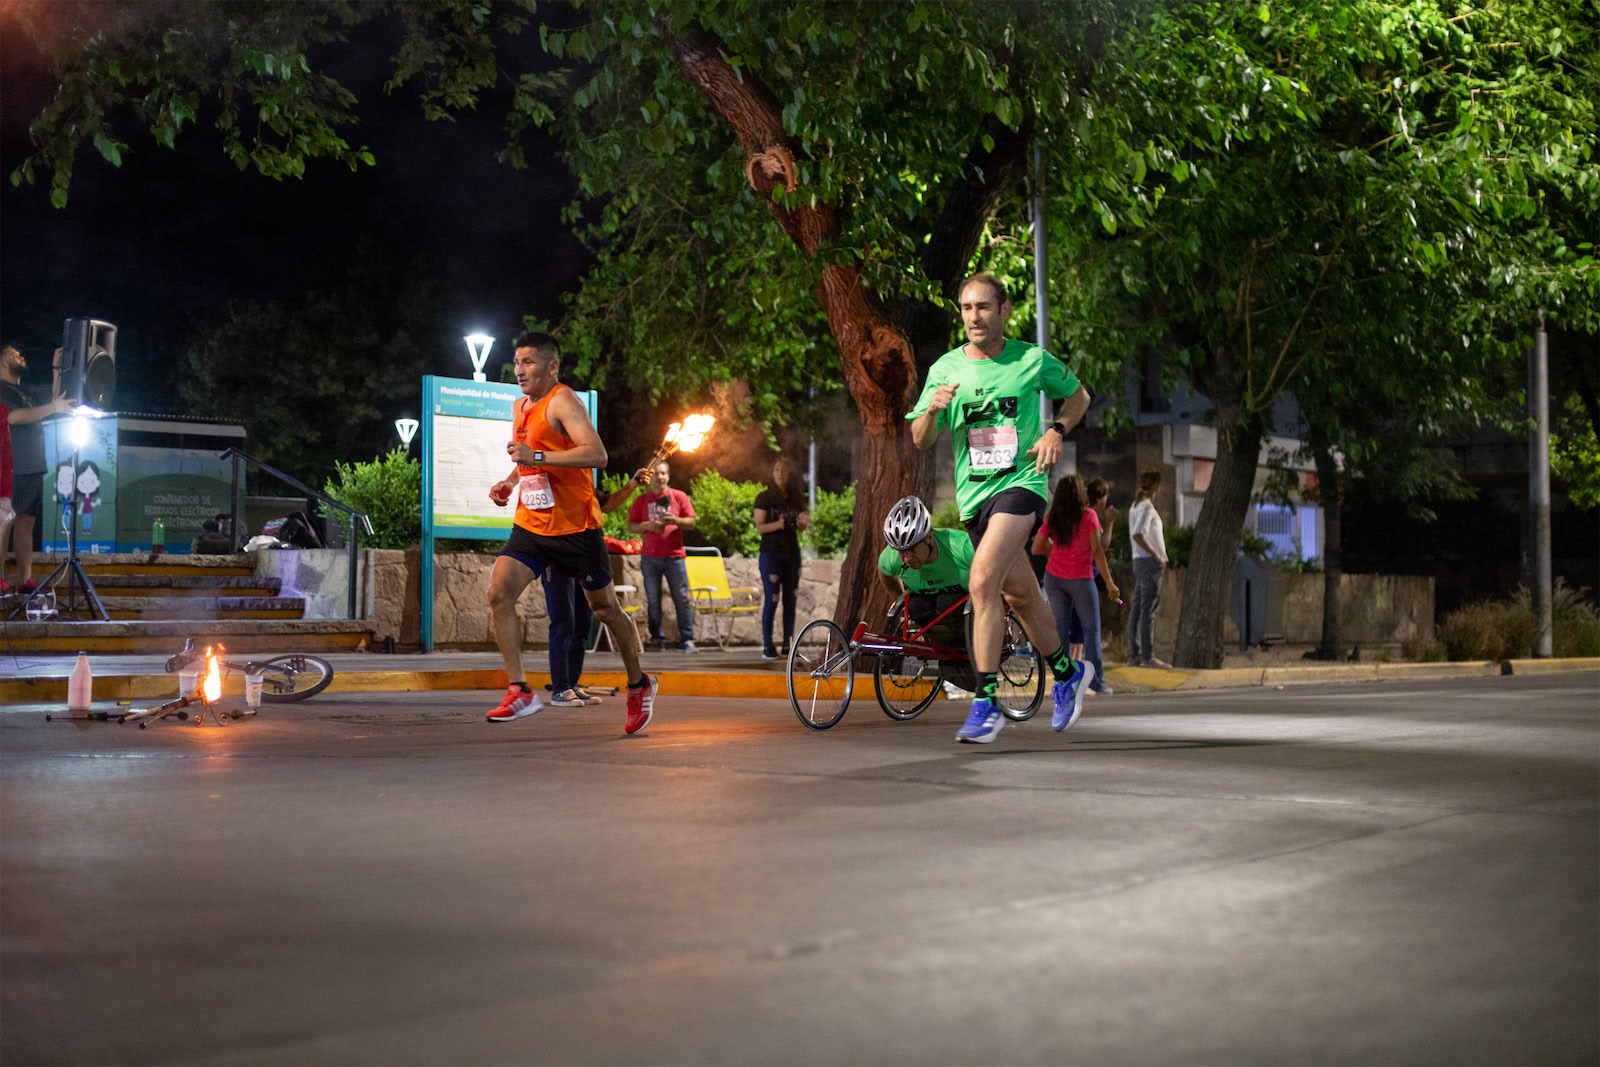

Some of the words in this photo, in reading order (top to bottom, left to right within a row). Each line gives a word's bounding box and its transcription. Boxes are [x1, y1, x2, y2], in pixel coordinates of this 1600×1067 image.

[440, 386, 481, 397] Municipalidad
[482, 390, 490, 398] de
[975, 449, 1013, 465] 2263
[524, 493, 549, 506] 2259
